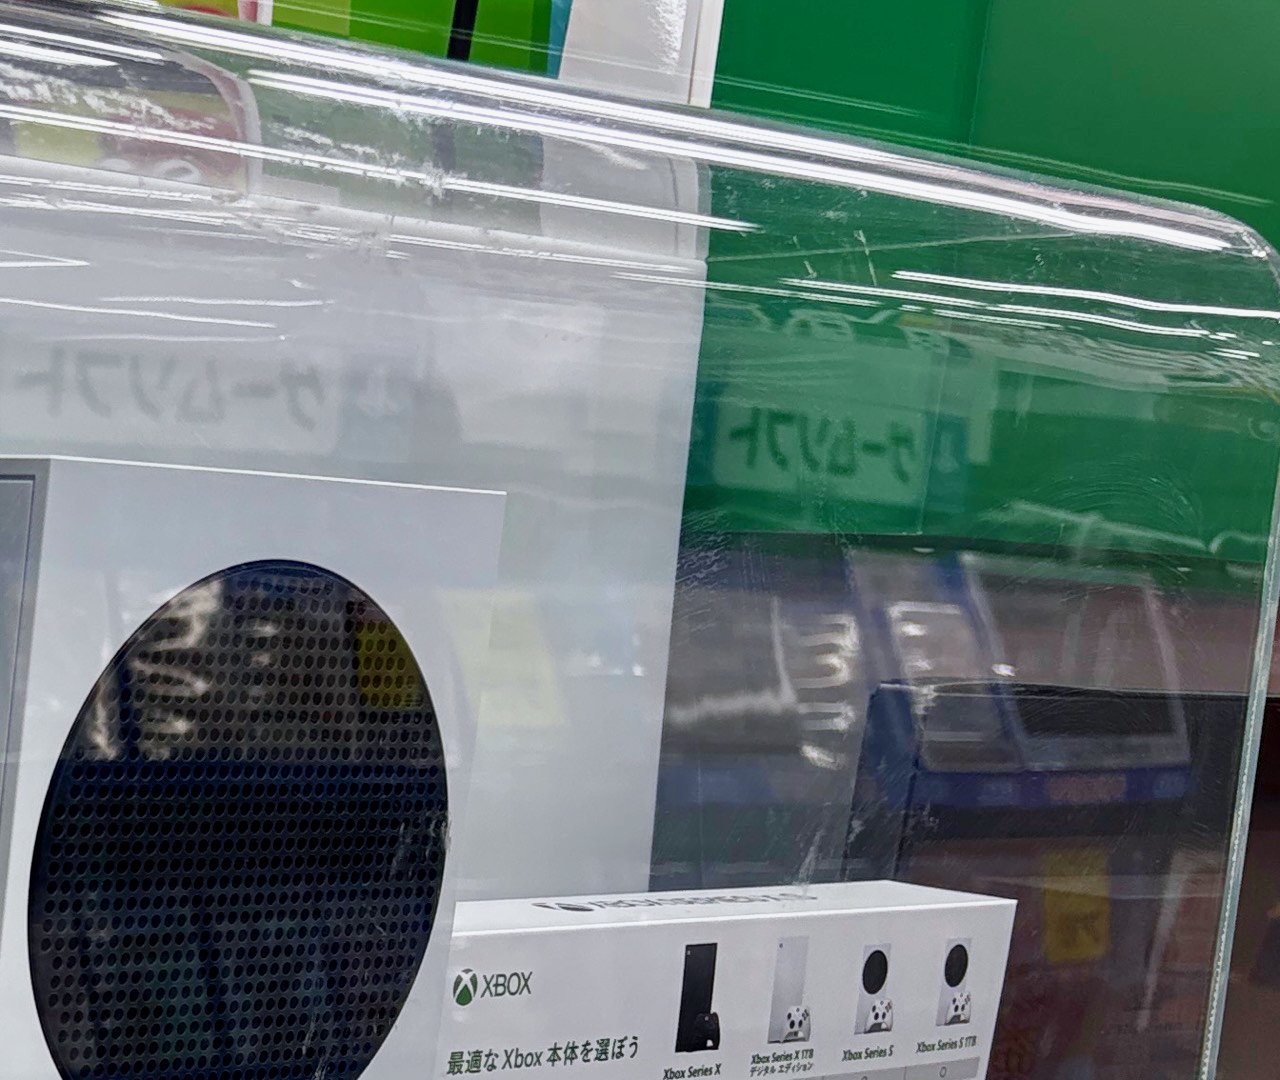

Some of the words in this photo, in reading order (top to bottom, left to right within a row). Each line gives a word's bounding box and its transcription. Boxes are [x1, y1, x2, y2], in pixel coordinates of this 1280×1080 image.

[480, 971, 534, 999] XBOX
[842, 1048, 864, 1062] Xbox
[864, 1045, 887, 1060] Series
[916, 1040, 937, 1054] Xbox
[936, 1037, 959, 1052] Series
[446, 1049, 500, 1076] 最適な
[501, 1044, 543, 1071] Xbox
[545, 1035, 639, 1066] 本体を選ぼう
[751, 1052, 771, 1065] Xbox
[770, 1049, 793, 1064] Series
[662, 1066, 687, 1080] Xbox
[687, 1064, 714, 1079] Series
[749, 1063, 778, 1078] デジタル
[777, 1061, 814, 1075] エディション
